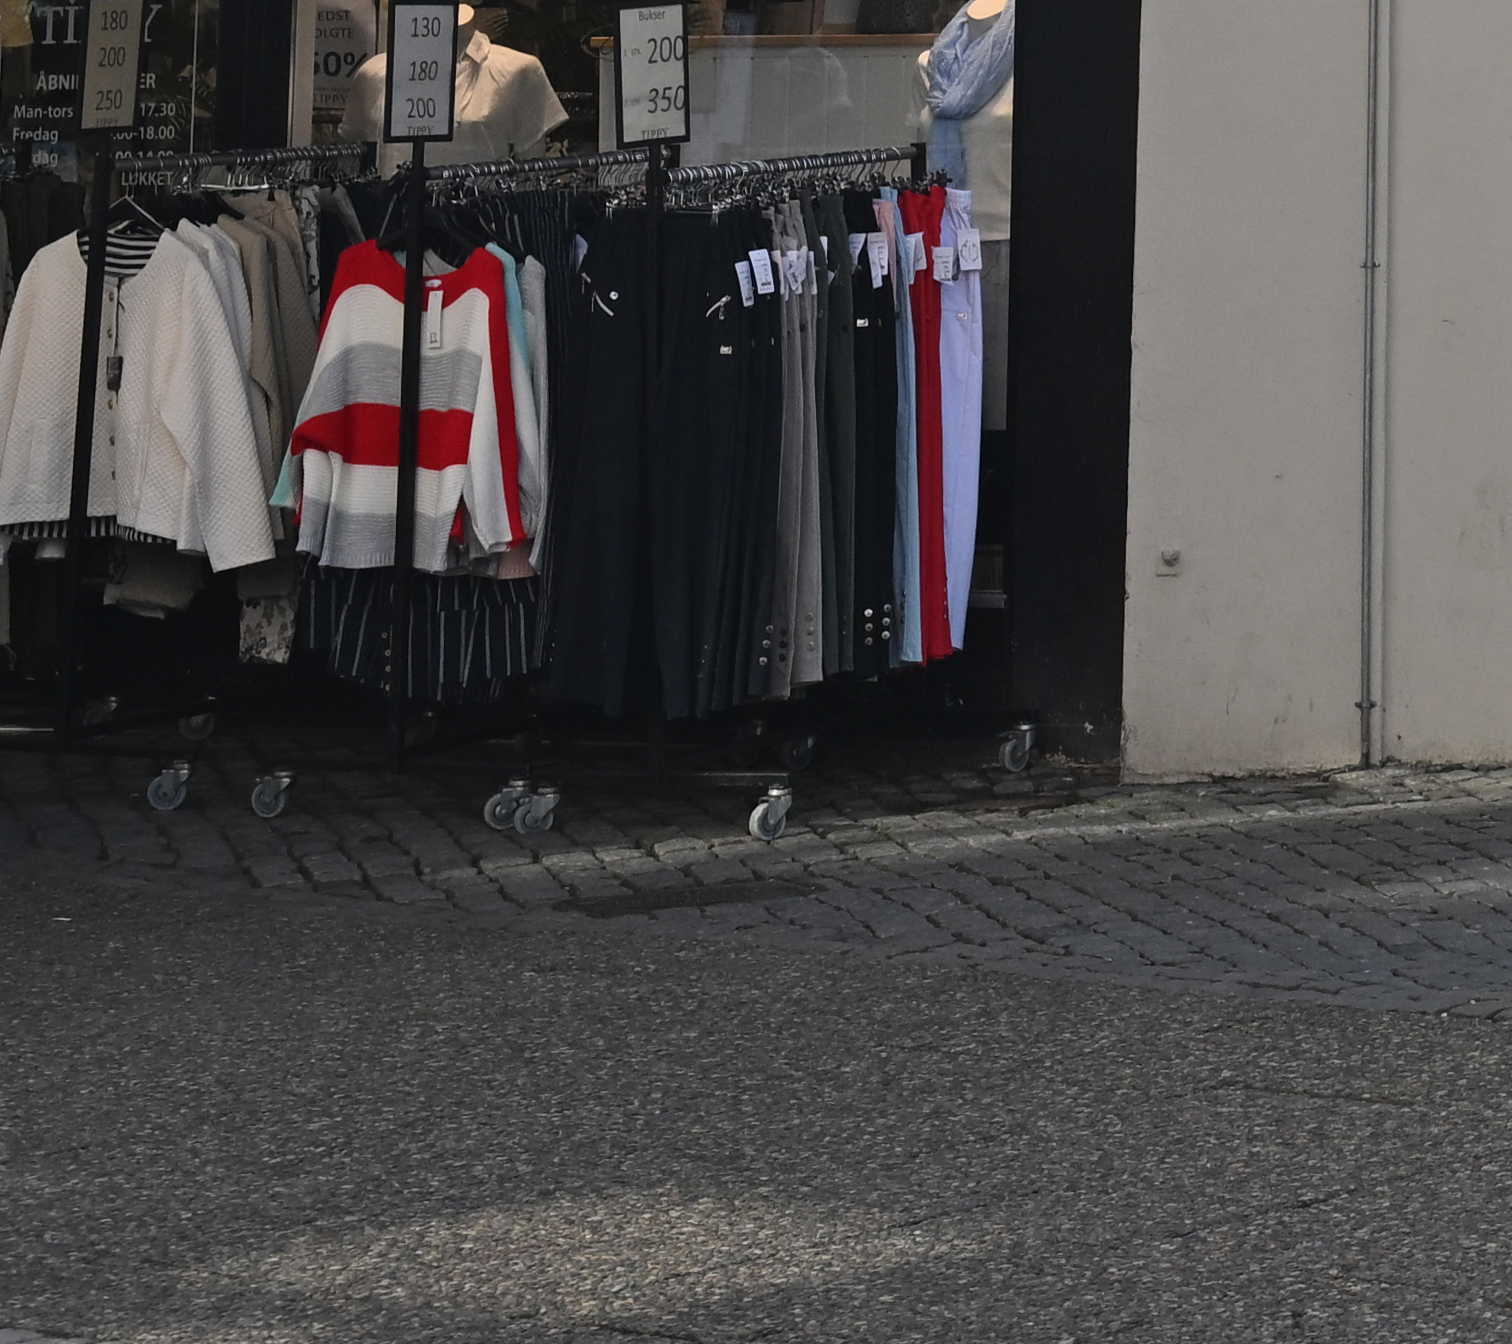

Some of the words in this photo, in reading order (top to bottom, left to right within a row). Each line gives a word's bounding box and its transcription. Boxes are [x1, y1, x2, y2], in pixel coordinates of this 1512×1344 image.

[101, 10, 128, 31] 180
[410, 16, 441, 38] 130
[98, 46, 126, 67] 200
[647, 35, 684, 64] 200
[408, 60, 438, 81] 180
[95, 90, 123, 110] 250
[405, 97, 436, 119] 200
[647, 85, 685, 113] 350
[12, 127, 59, 144] Fredag
